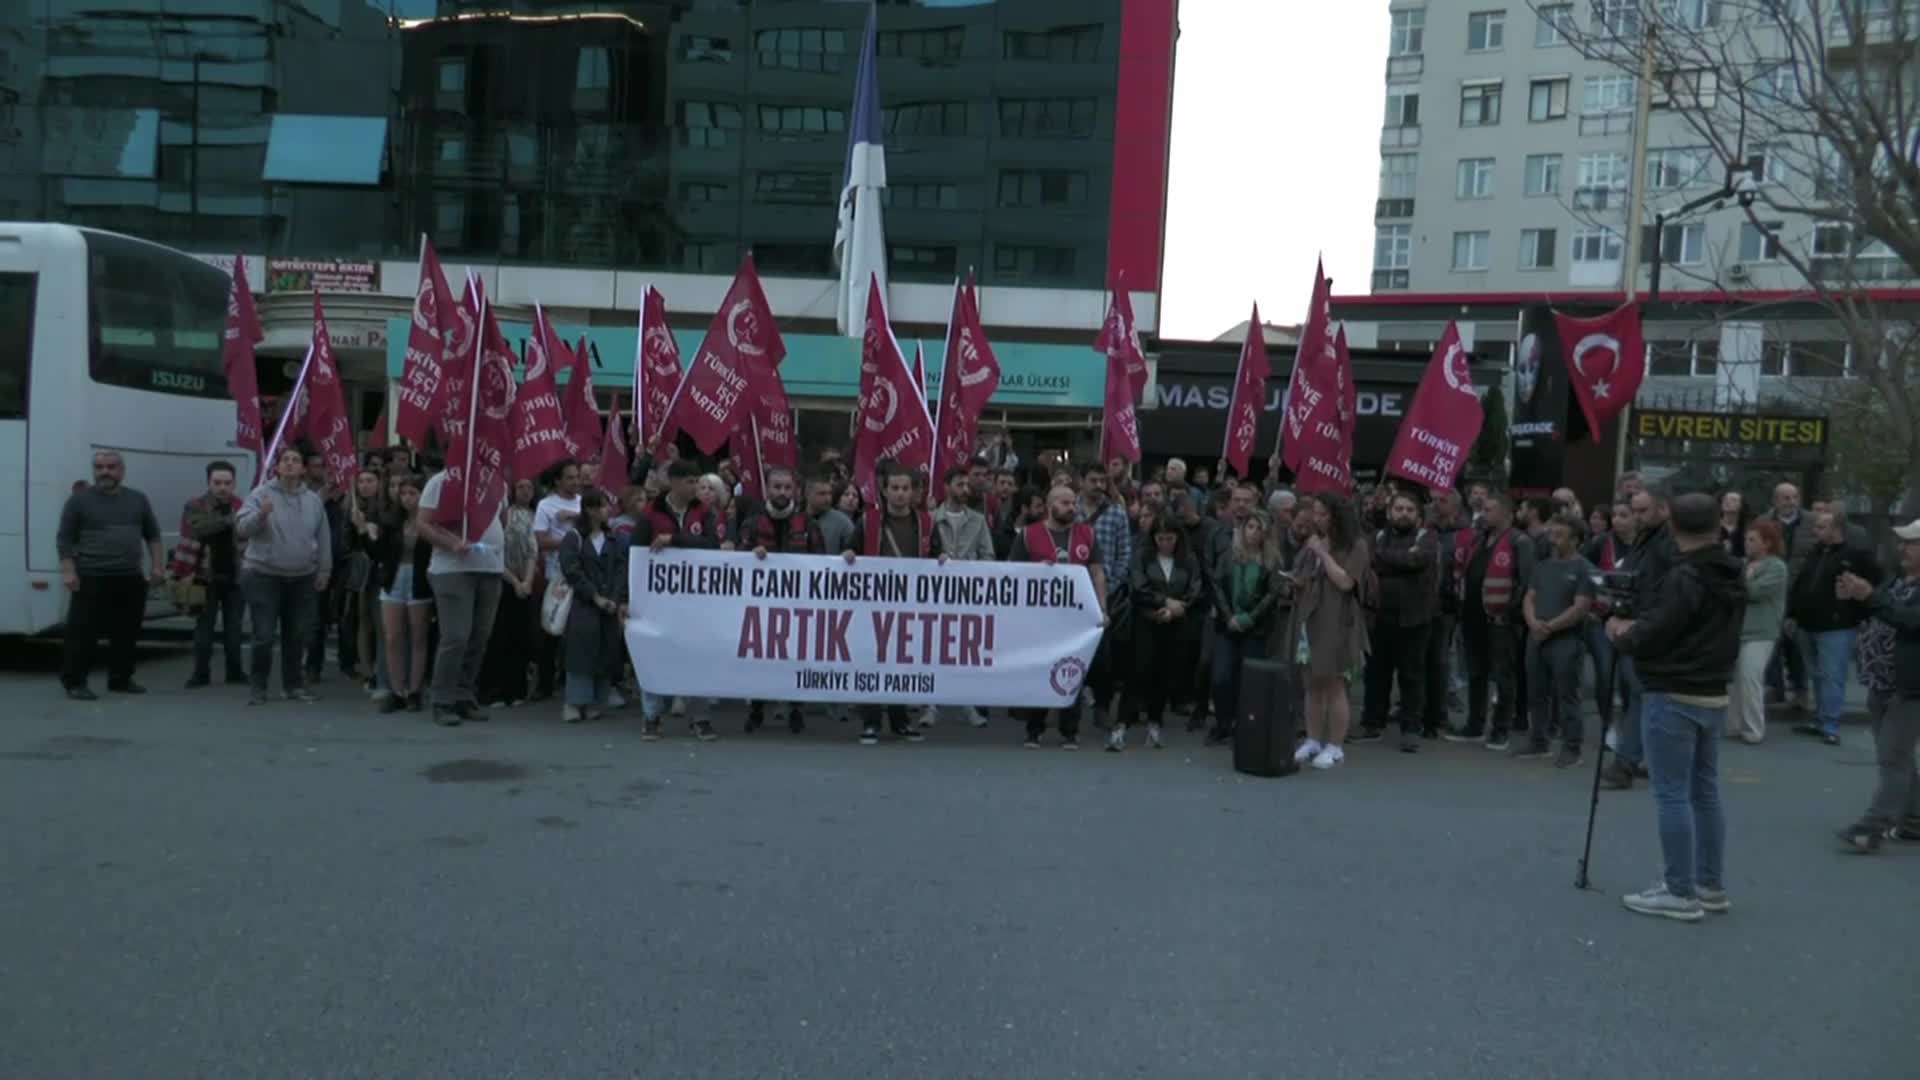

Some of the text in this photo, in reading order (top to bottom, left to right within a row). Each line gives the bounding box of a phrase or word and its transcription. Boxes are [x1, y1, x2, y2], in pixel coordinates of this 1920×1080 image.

[151, 368, 206, 392] ISUZU
[703, 351, 749, 392] TÜRKİYE
[1027, 373, 1071, 389] ÜLKESİ
[715, 382, 740, 408] İŞÇİ
[1410, 426, 1460, 457] TÜRKİYE
[1639, 414, 1825, 444] EVREN SİTESİ
[1401, 458, 1451, 489] PARTİSİ
[648, 559, 1084, 611] İŞÇİLERİN CANI KİMSENİN OYUNCAĞI DEĞİL,
[737, 605, 995, 667] ARTIK YETER!
[796, 668, 935, 694] TÜRKİYE İŞÇİ PARTİSİ
